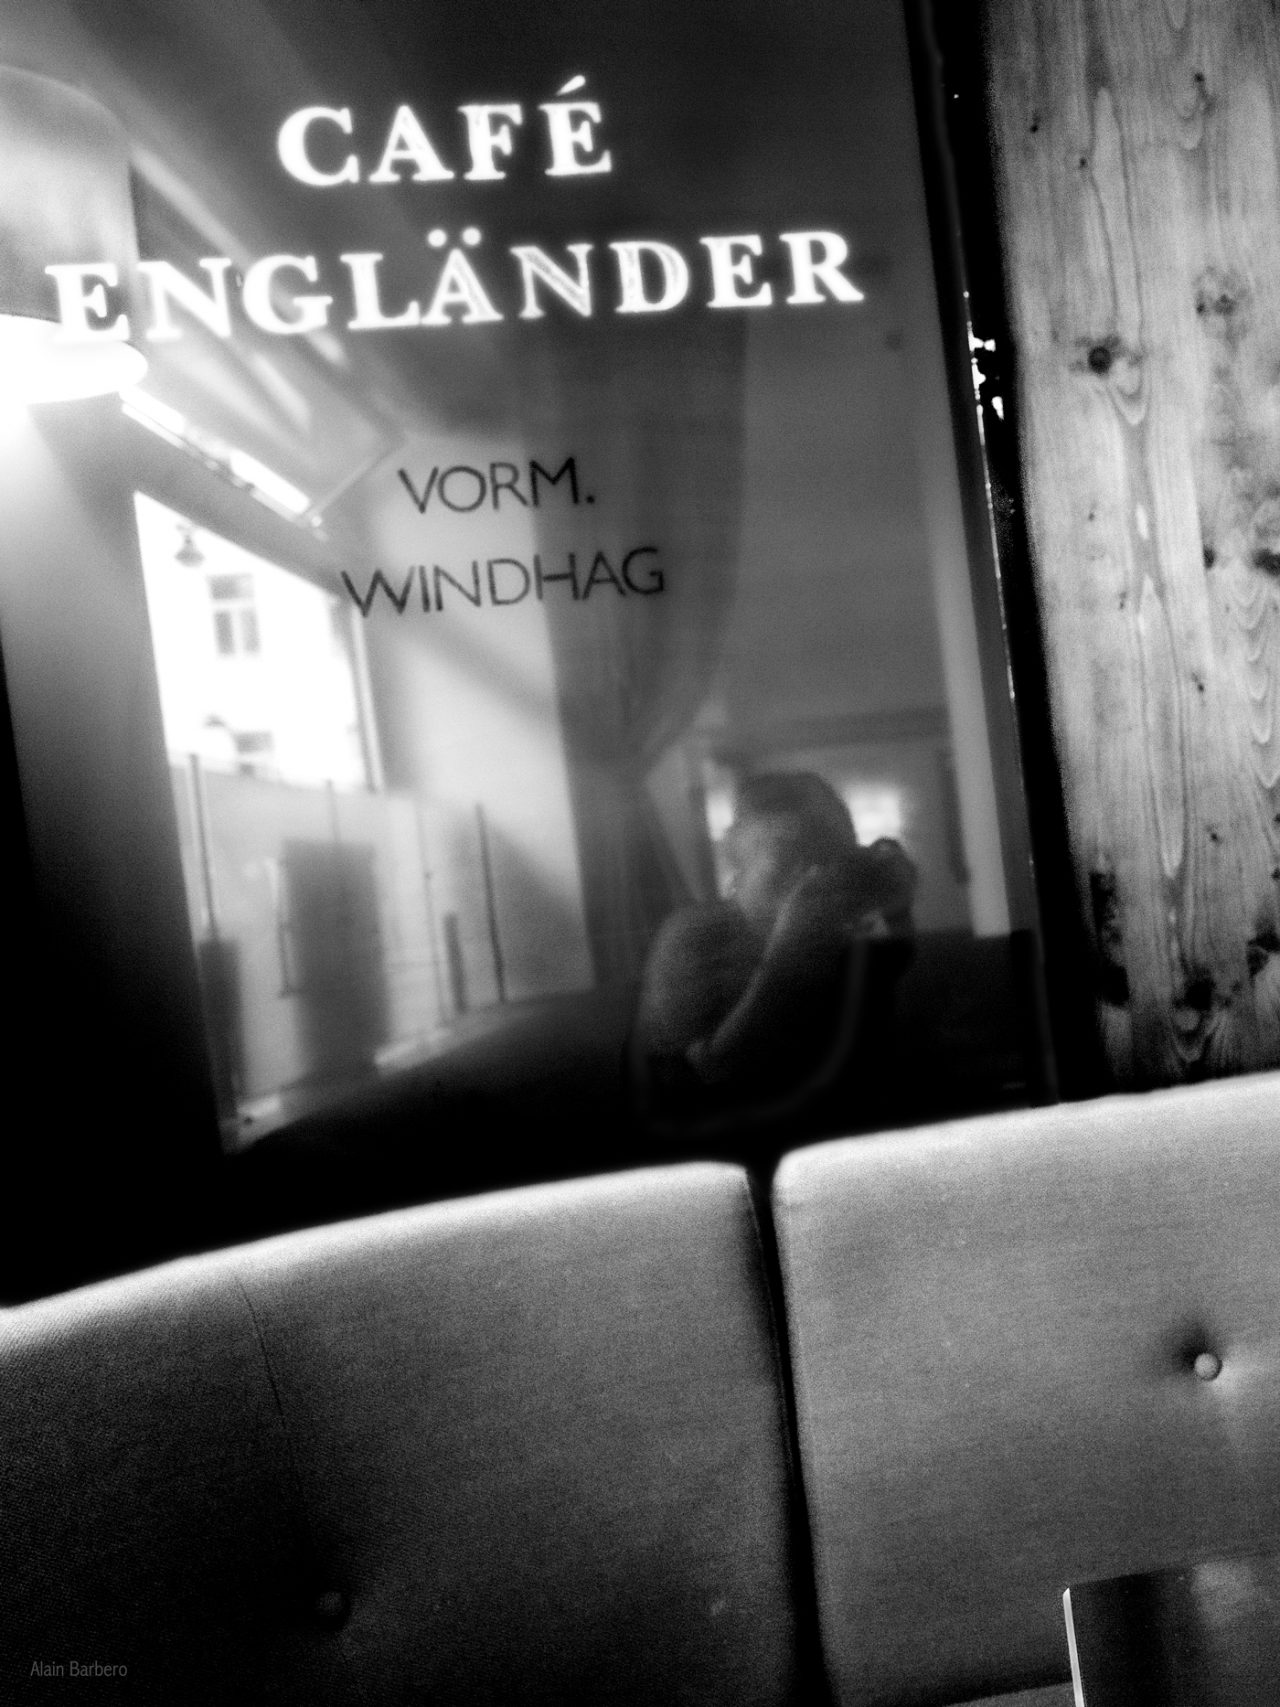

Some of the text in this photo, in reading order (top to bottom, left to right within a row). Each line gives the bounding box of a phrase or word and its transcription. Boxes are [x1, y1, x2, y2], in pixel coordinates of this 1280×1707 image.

[276, 75, 612, 187] CAFÉ
[44, 228, 864, 343] ENGLÄNDER
[397, 457, 596, 514] VORM.
[341, 546, 665, 618] WINDHAG
